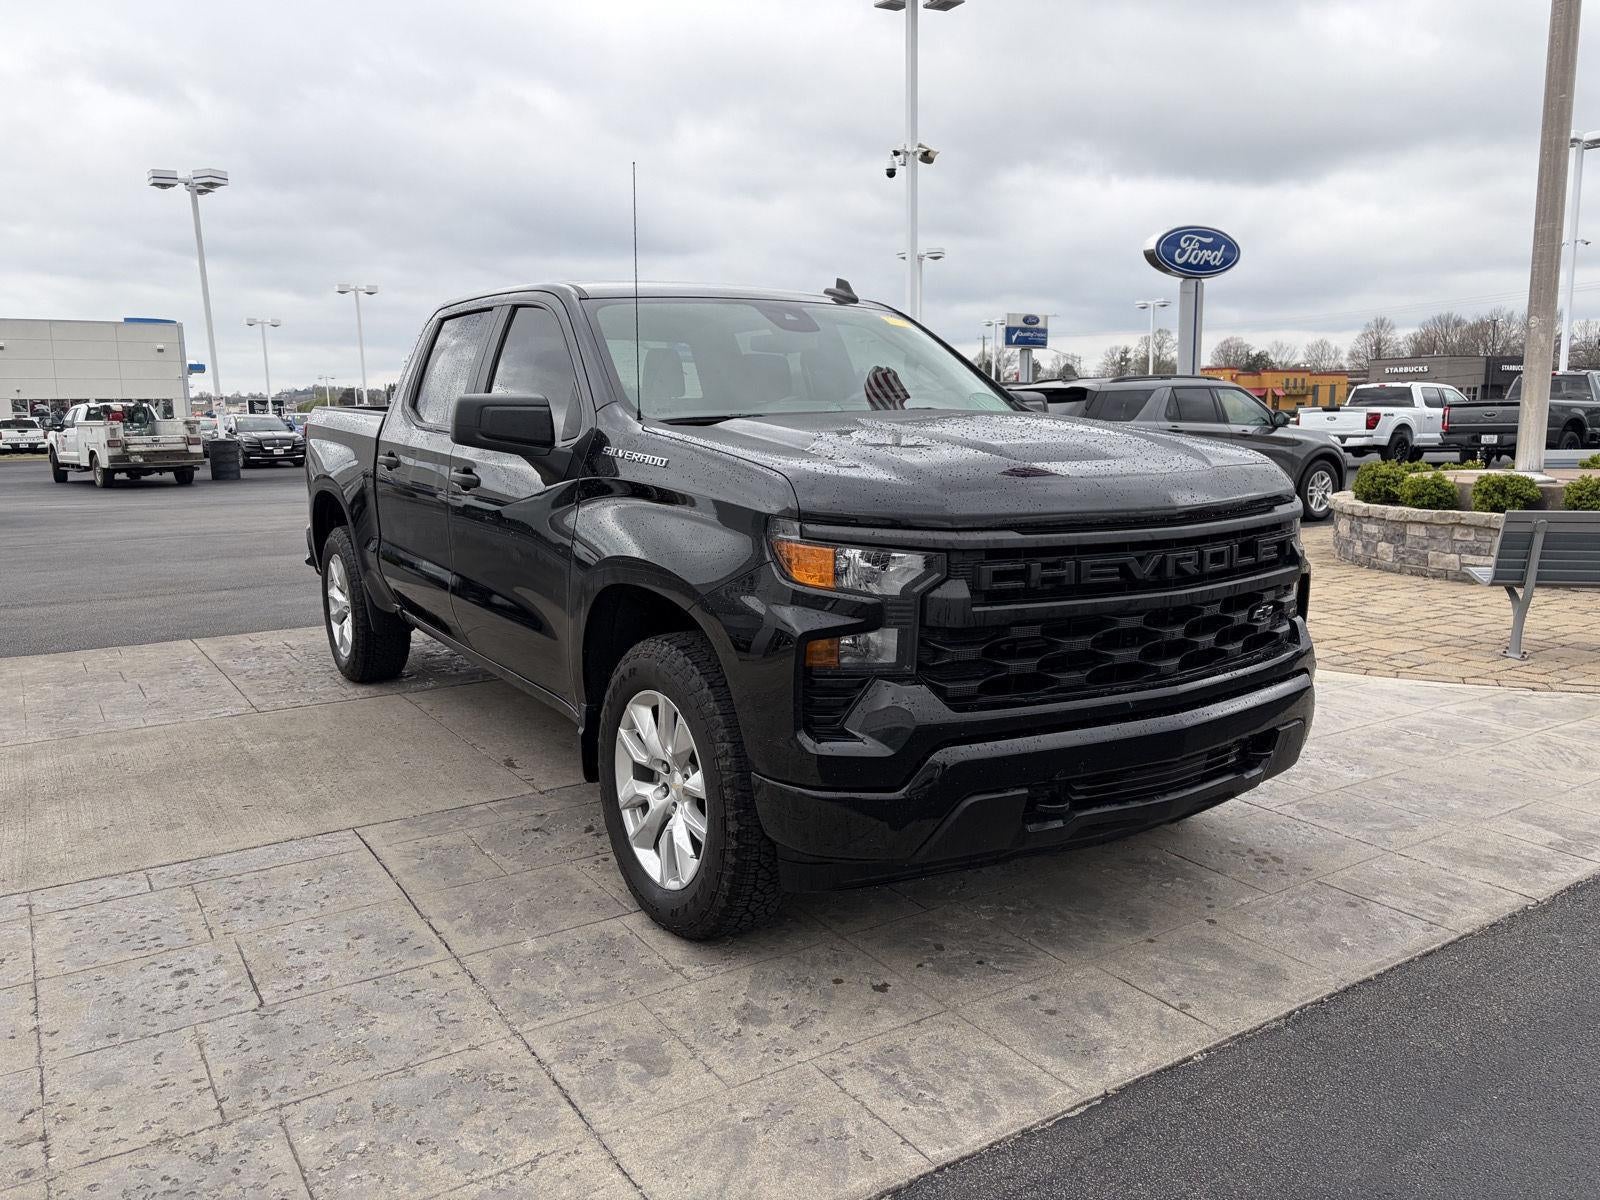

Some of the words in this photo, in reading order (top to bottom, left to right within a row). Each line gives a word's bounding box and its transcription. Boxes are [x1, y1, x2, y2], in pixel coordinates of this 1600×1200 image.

[1174, 234, 1226, 266] Ford
[1384, 365, 1429, 374] STARBUCKS
[602, 446, 669, 467] SILVERADO
[977, 533, 1298, 589] CHEVROLET
